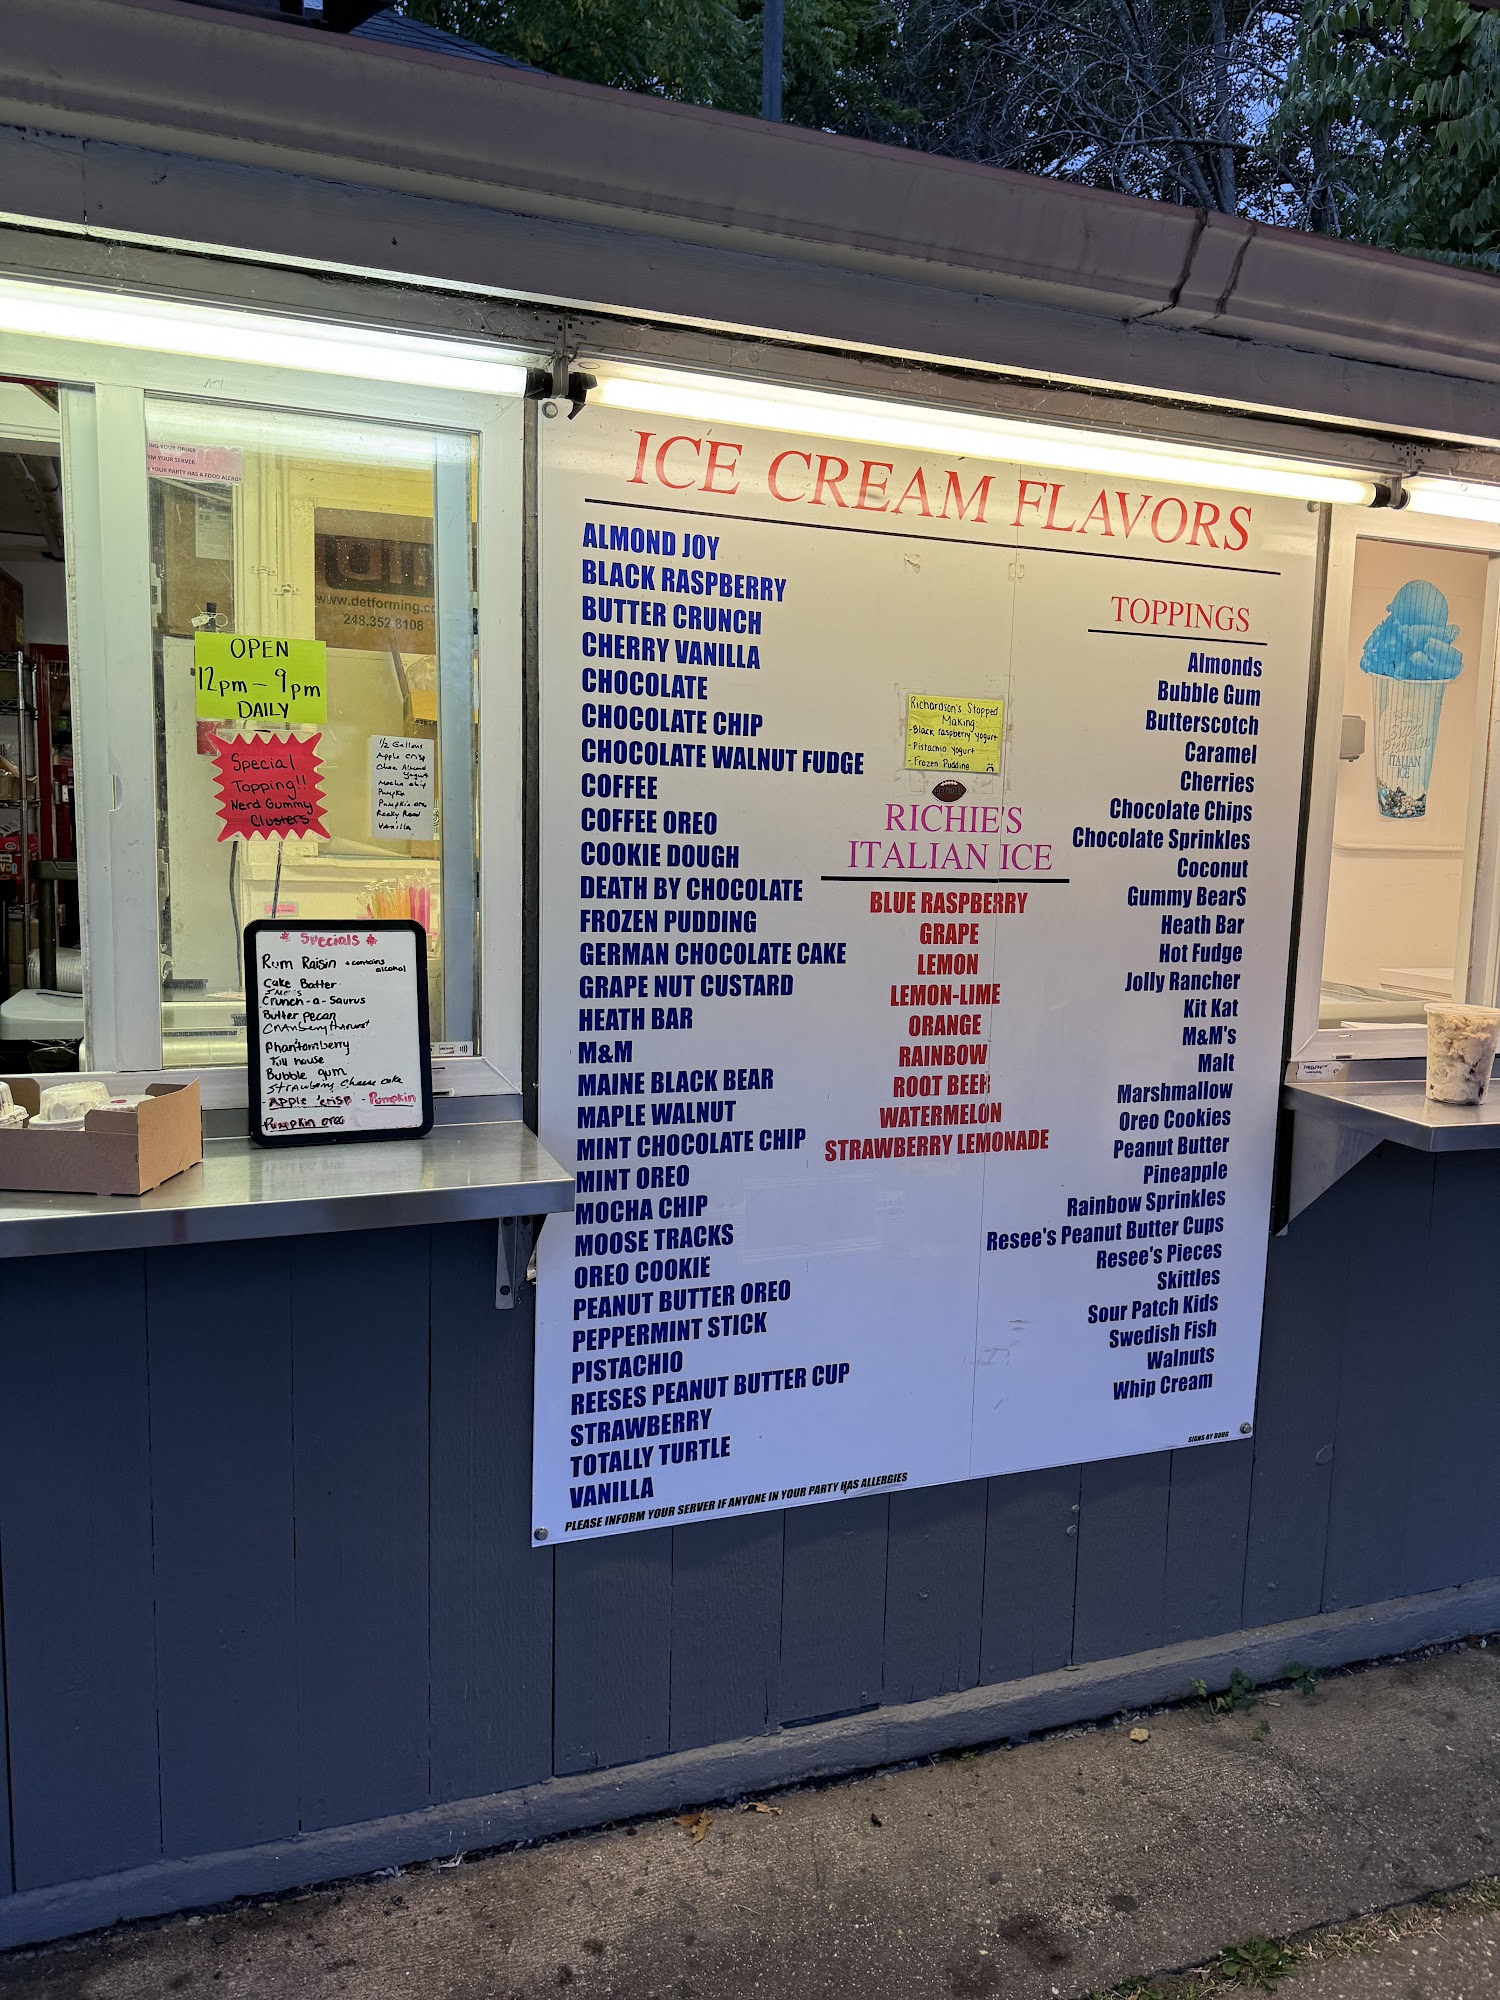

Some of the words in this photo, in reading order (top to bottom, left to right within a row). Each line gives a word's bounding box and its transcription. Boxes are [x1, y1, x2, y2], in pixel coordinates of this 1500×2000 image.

[628, 431, 742, 495] ICE
[767, 450, 996, 524] CREAM
[1011, 479, 1253, 551] FLAVORS
[582, 522, 675, 556] ALMOND
[682, 534, 717, 561] JOY
[344, 614, 424, 631] 248.352.8108
[1111, 596, 1250, 633] TOPPINGS
[230, 639, 288, 658] OPEN
[1187, 652, 1262, 677] Almonds
[199, 666, 247, 697] 12pm
[275, 669, 321, 700] 9pm
[582, 667, 708, 700] CHOCOLATE
[237, 701, 288, 718] DAILY
[910, 696, 962, 714] Richardson's
[967, 703, 998, 718] Stopped
[1145, 709, 1259, 736] Butterscotch
[231, 753, 295, 773] Special
[582, 738, 706, 768] CHOCOLATE
[711, 745, 798, 772] WALNUT
[802, 750, 864, 775] FUDGE
[943, 759, 969, 770] Pudding
[1389, 755, 1421, 767] ITALIAN
[1180, 770, 1254, 793] Cherries
[1397, 766, 1410, 779] ICE
[232, 775, 307, 800] Topping!!
[231, 800, 261, 810] Nerd
[266, 799, 313, 815] Gummy
[885, 803, 1022, 833] RICHIE'S
[251, 815, 310, 827] Clusters
[1072, 827, 1164, 849] Chocolate
[1168, 828, 1251, 851] Sprinkles
[848, 841, 988, 870] ITALIAN
[999, 844, 1053, 871] ICE
[581, 876, 647, 900] DEATH
[654, 877, 681, 900] BY
[686, 877, 803, 901] CHOCOLATE
[1127, 886, 1193, 908] Gummy
[1196, 886, 1246, 906] BearS
[870, 891, 916, 914] BLUE
[921, 892, 1028, 914] RASPBERRY
[920, 922, 979, 945] GRAPE
[262, 954, 293, 969] Rum
[302, 956, 337, 969] Raisin
[580, 942, 669, 966] GERMAN
[675, 942, 792, 965] CHOCOLATE
[797, 942, 846, 965] CAKE
[917, 953, 979, 975] LEMON
[1159, 943, 1188, 963] Hot
[1192, 942, 1243, 965] Fudge
[890, 983, 1001, 1007] LEMON-LIME
[1183, 999, 1207, 1018] Kit
[1211, 998, 1239, 1018] Kat
[908, 1014, 981, 1037] ORANGE
[899, 1044, 988, 1067] RAINBOW
[1198, 1052, 1235, 1073] Malt
[266, 1068, 307, 1080] Bubble
[578, 1072, 645, 1097] MAINE
[651, 1069, 718, 1094] BLACK
[723, 1068, 774, 1091] BEAR
[893, 1075, 943, 1098] ROOT
[880, 1102, 1002, 1128] WATERMELON
[1119, 1111, 1159, 1132] Oreo
[1164, 1108, 1231, 1129] Cookies
[577, 1136, 632, 1161] MINT
[637, 1130, 754, 1158] CHOCOLATE
[759, 1128, 806, 1151] CHIP
[825, 1134, 953, 1162] STRAWBERRY
[957, 1129, 1049, 1155] LEMONADE
[1143, 1161, 1228, 1184] Pineapple
[987, 1227, 1057, 1251] Resee's
[1061, 1223, 1122, 1245] Peanut
[1126, 1219, 1179, 1240] Butter
[1183, 1216, 1224, 1235] Cups
[575, 1263, 629, 1289] OREO
[635, 1256, 710, 1284] COOKIE
[1157, 1268, 1220, 1290] Skittles
[572, 1318, 703, 1353] PEPPERMINT
[707, 1311, 767, 1338] STICK
[1109, 1323, 1180, 1349] Swedish
[1184, 1319, 1217, 1340] Fish
[571, 1385, 646, 1416] REESES
[652, 1376, 729, 1406] PEANUT
[734, 1367, 806, 1396] BUTTER
[812, 1362, 850, 1387] CUP
[1113, 1378, 1156, 1401] Whip
[1160, 1373, 1213, 1394] Cream
[571, 1446, 654, 1478] TOTALLY
[659, 1435, 730, 1466] TURTLE
[565, 1516, 603, 1532] PLEASE
[604, 1510, 645, 1526] INFORM
[648, 1506, 675, 1520] YOUR
[677, 1500, 715, 1515] SERVER
[717, 1497, 727, 1509] IF
[728, 1491, 767, 1507] ANYONE
[768, 1491, 779, 1502] IN
[781, 1487, 807, 1500] YOUR
[808, 1482, 839, 1496] PARTY
[860, 1472, 908, 1488] ALLERGIES
[570, 1477, 654, 1509] VANILLA
